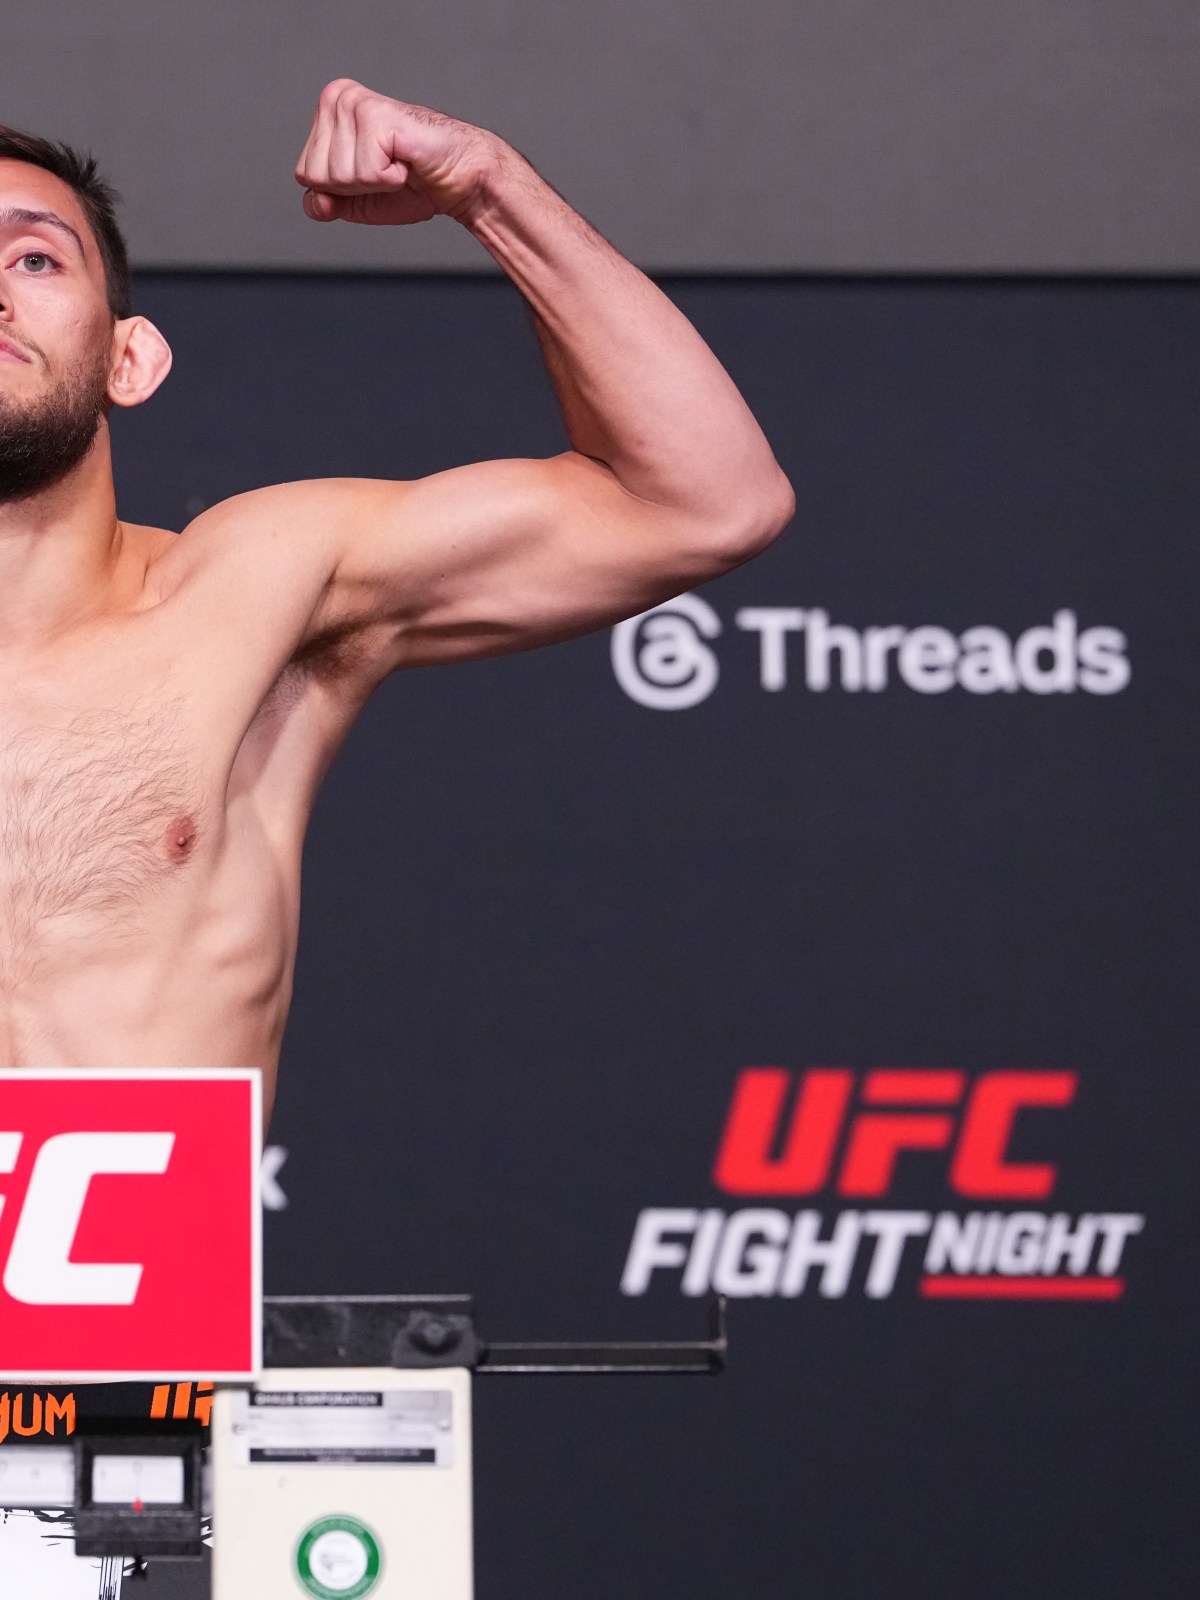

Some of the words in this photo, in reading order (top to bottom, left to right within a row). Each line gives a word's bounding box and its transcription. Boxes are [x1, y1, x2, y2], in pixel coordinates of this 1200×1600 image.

[736, 607, 1131, 695] Threads
[713, 1067, 1077, 1199] UFC
[620, 1208, 931, 1298] FIGHT
[924, 1211, 1143, 1275] NIGHT
